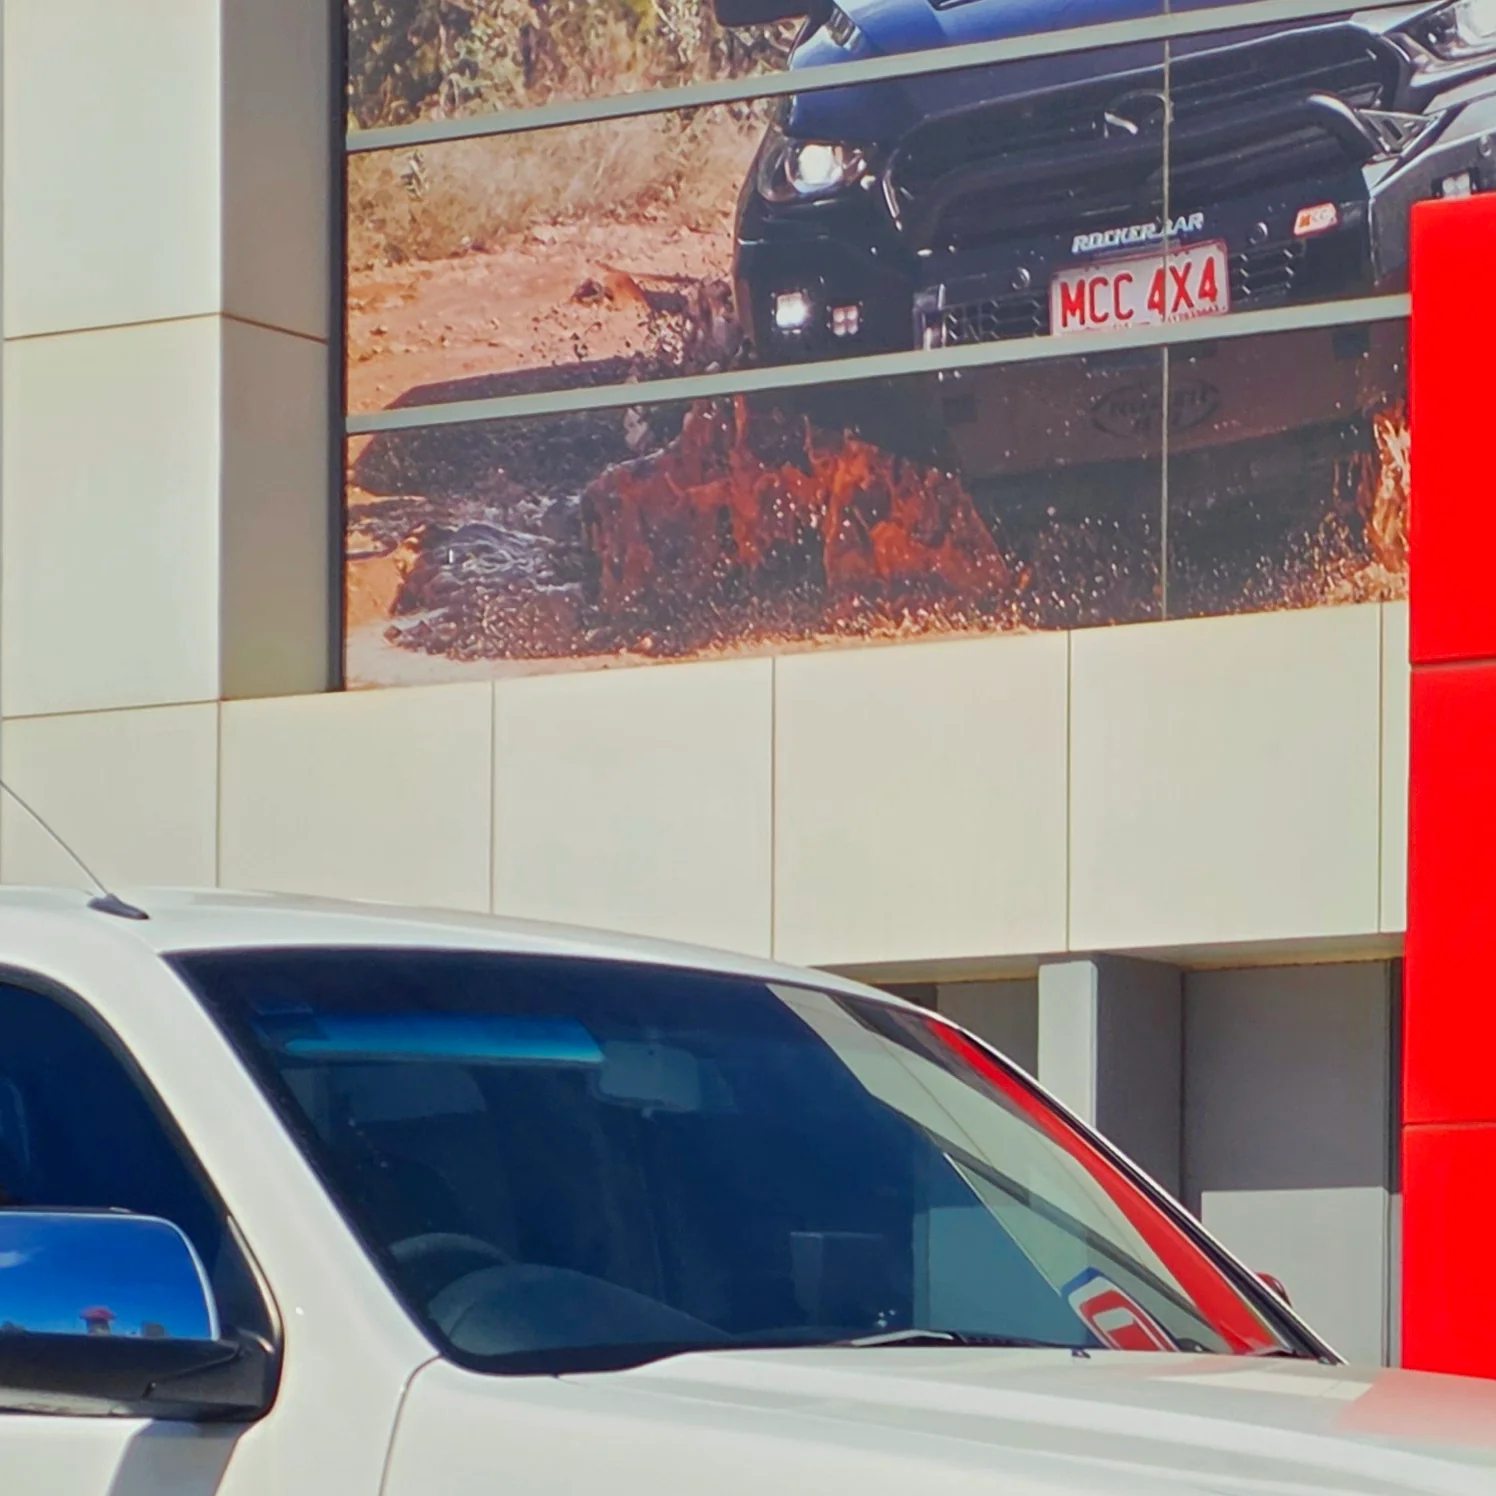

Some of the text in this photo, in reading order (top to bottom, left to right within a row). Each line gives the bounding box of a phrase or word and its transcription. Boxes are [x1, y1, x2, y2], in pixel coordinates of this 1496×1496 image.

[1071, 222, 1157, 254] ROCKER
[1060, 256, 1218, 328] MCC 4X4
